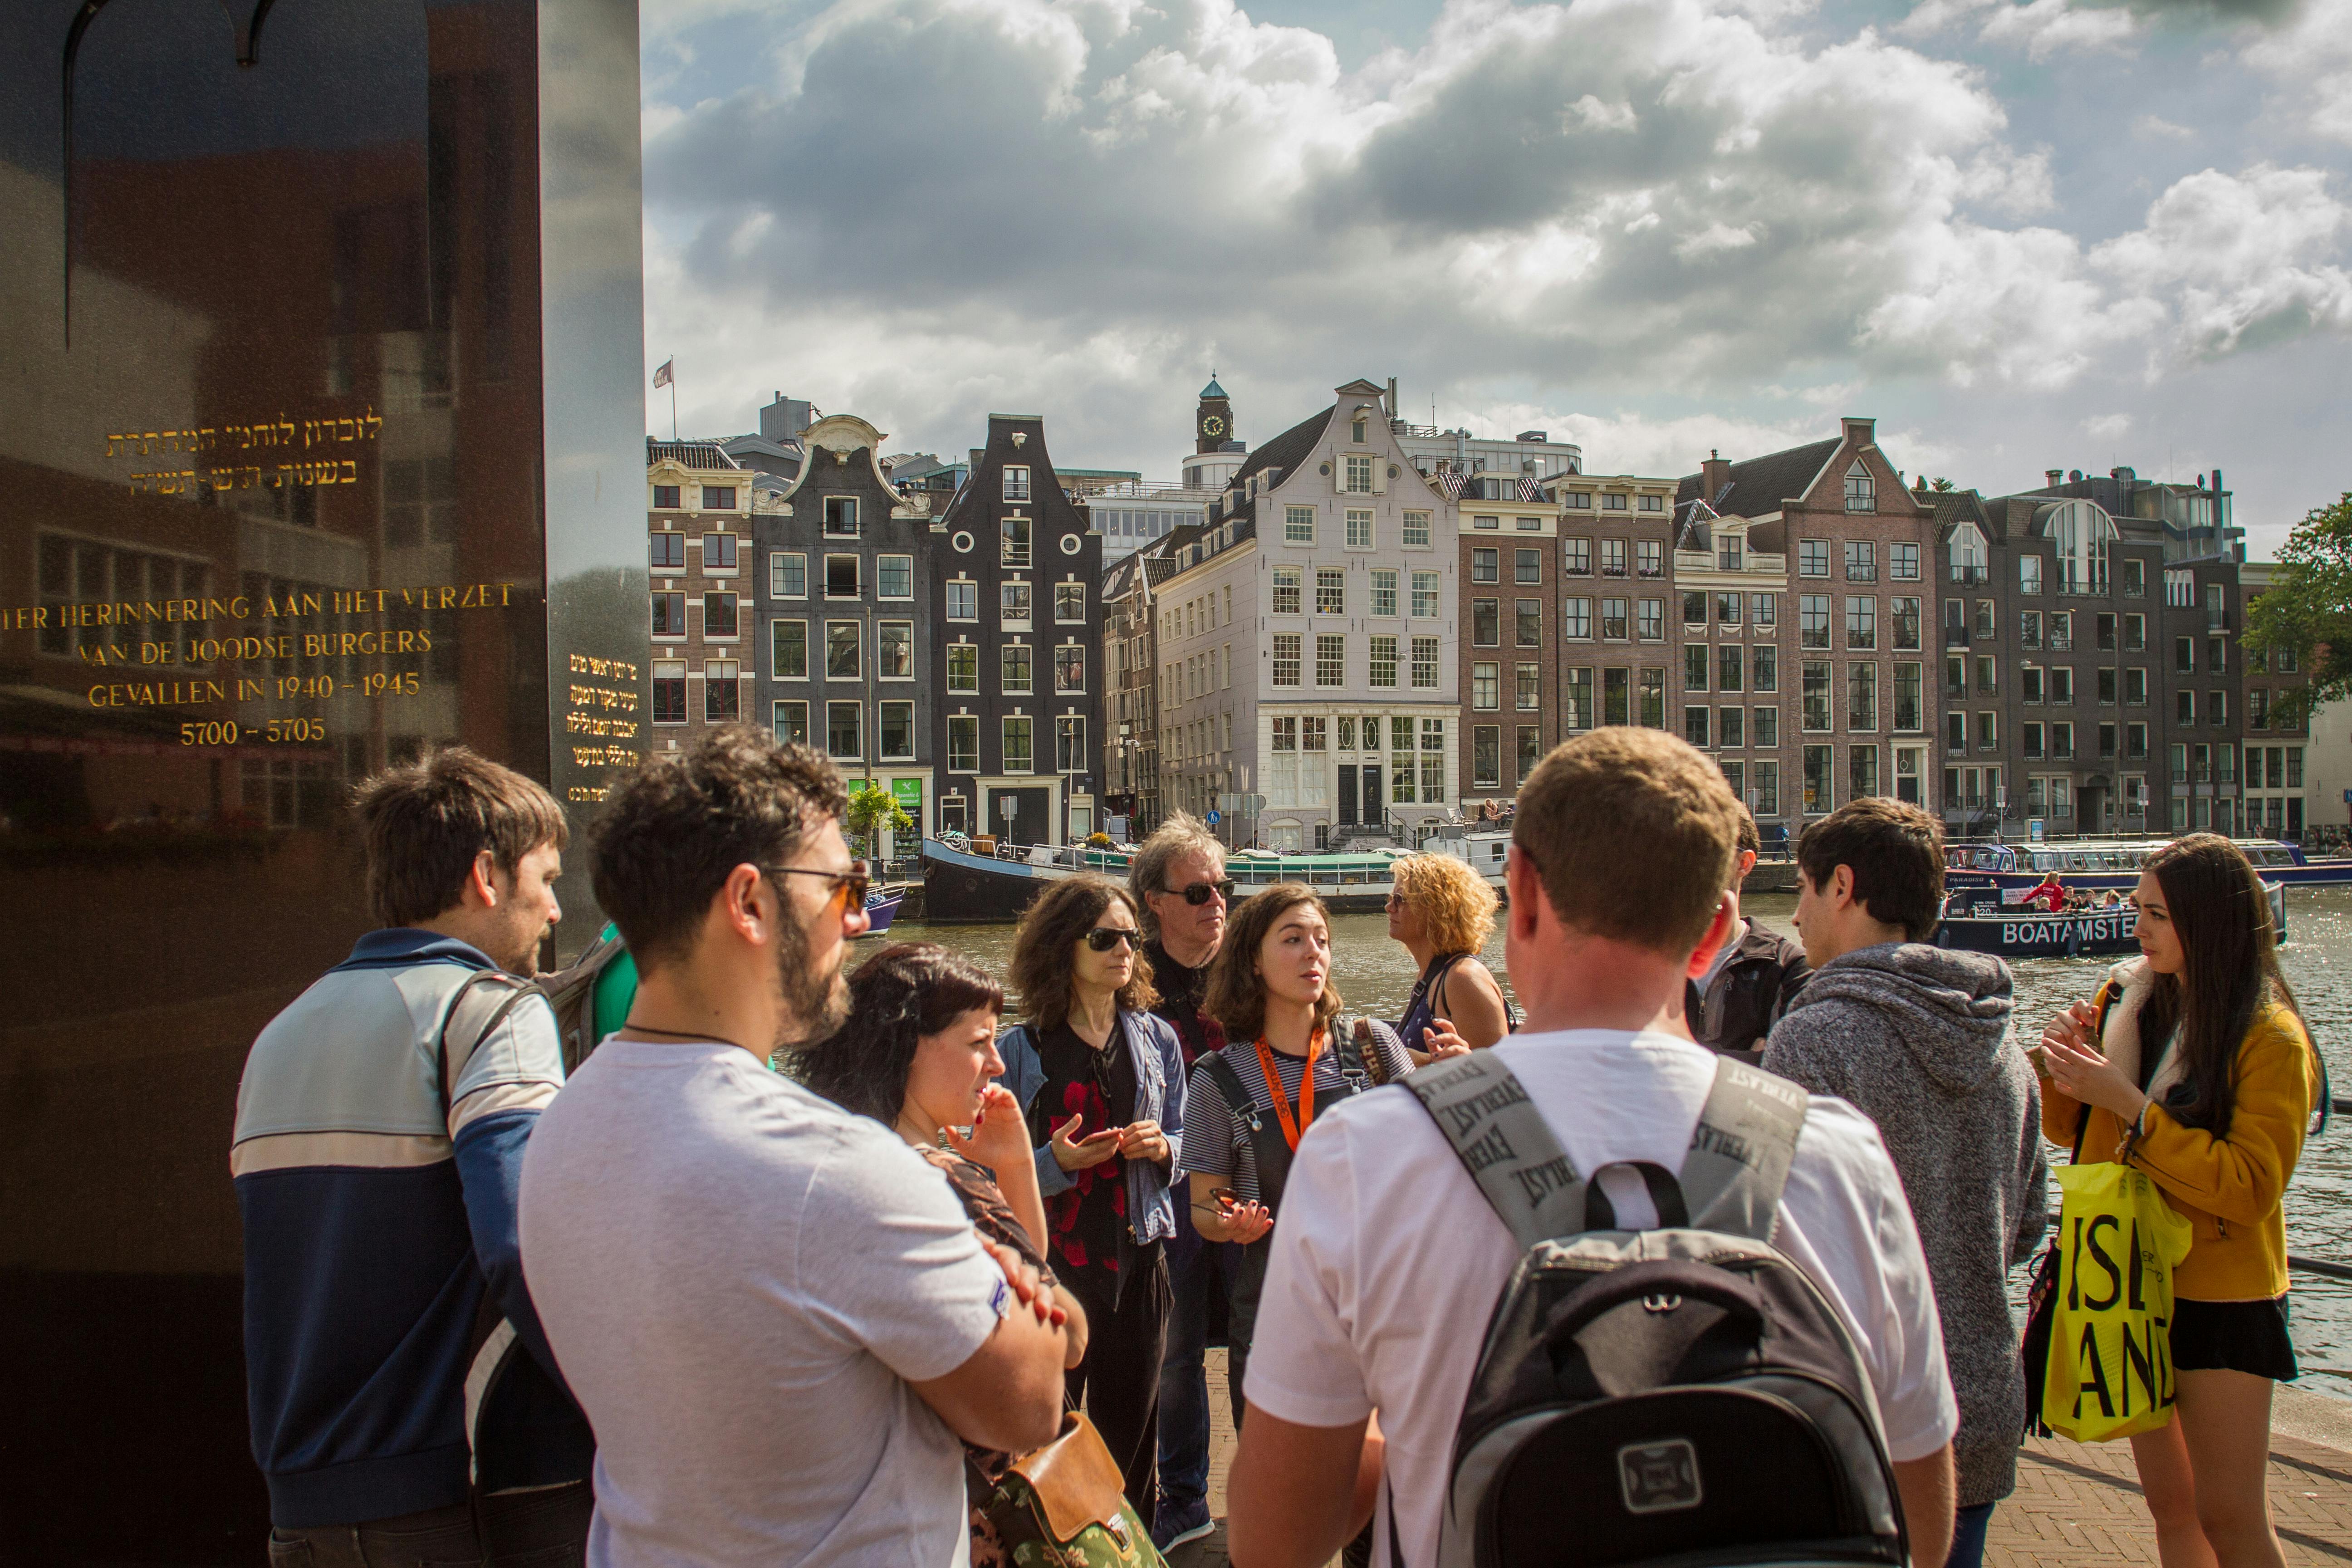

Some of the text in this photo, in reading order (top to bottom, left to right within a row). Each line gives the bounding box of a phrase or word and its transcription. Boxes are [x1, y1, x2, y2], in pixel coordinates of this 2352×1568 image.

[1, 582, 515, 630] TER HERINNERING AAN HET VERZET
[78, 629, 432, 667] VAN DE JOODSE BURGERS
[88, 681, 225, 708] GEVALLEN
[237, 679, 265, 702] IN
[276, 675, 333, 701] 1940
[363, 671, 420, 697] 1945
[181, 720, 238, 746] 5700
[266, 717, 325, 743] 5705
[2003, 917, 2138, 944] BOATAMSTE
[1276, 1095, 1289, 1118] 360
